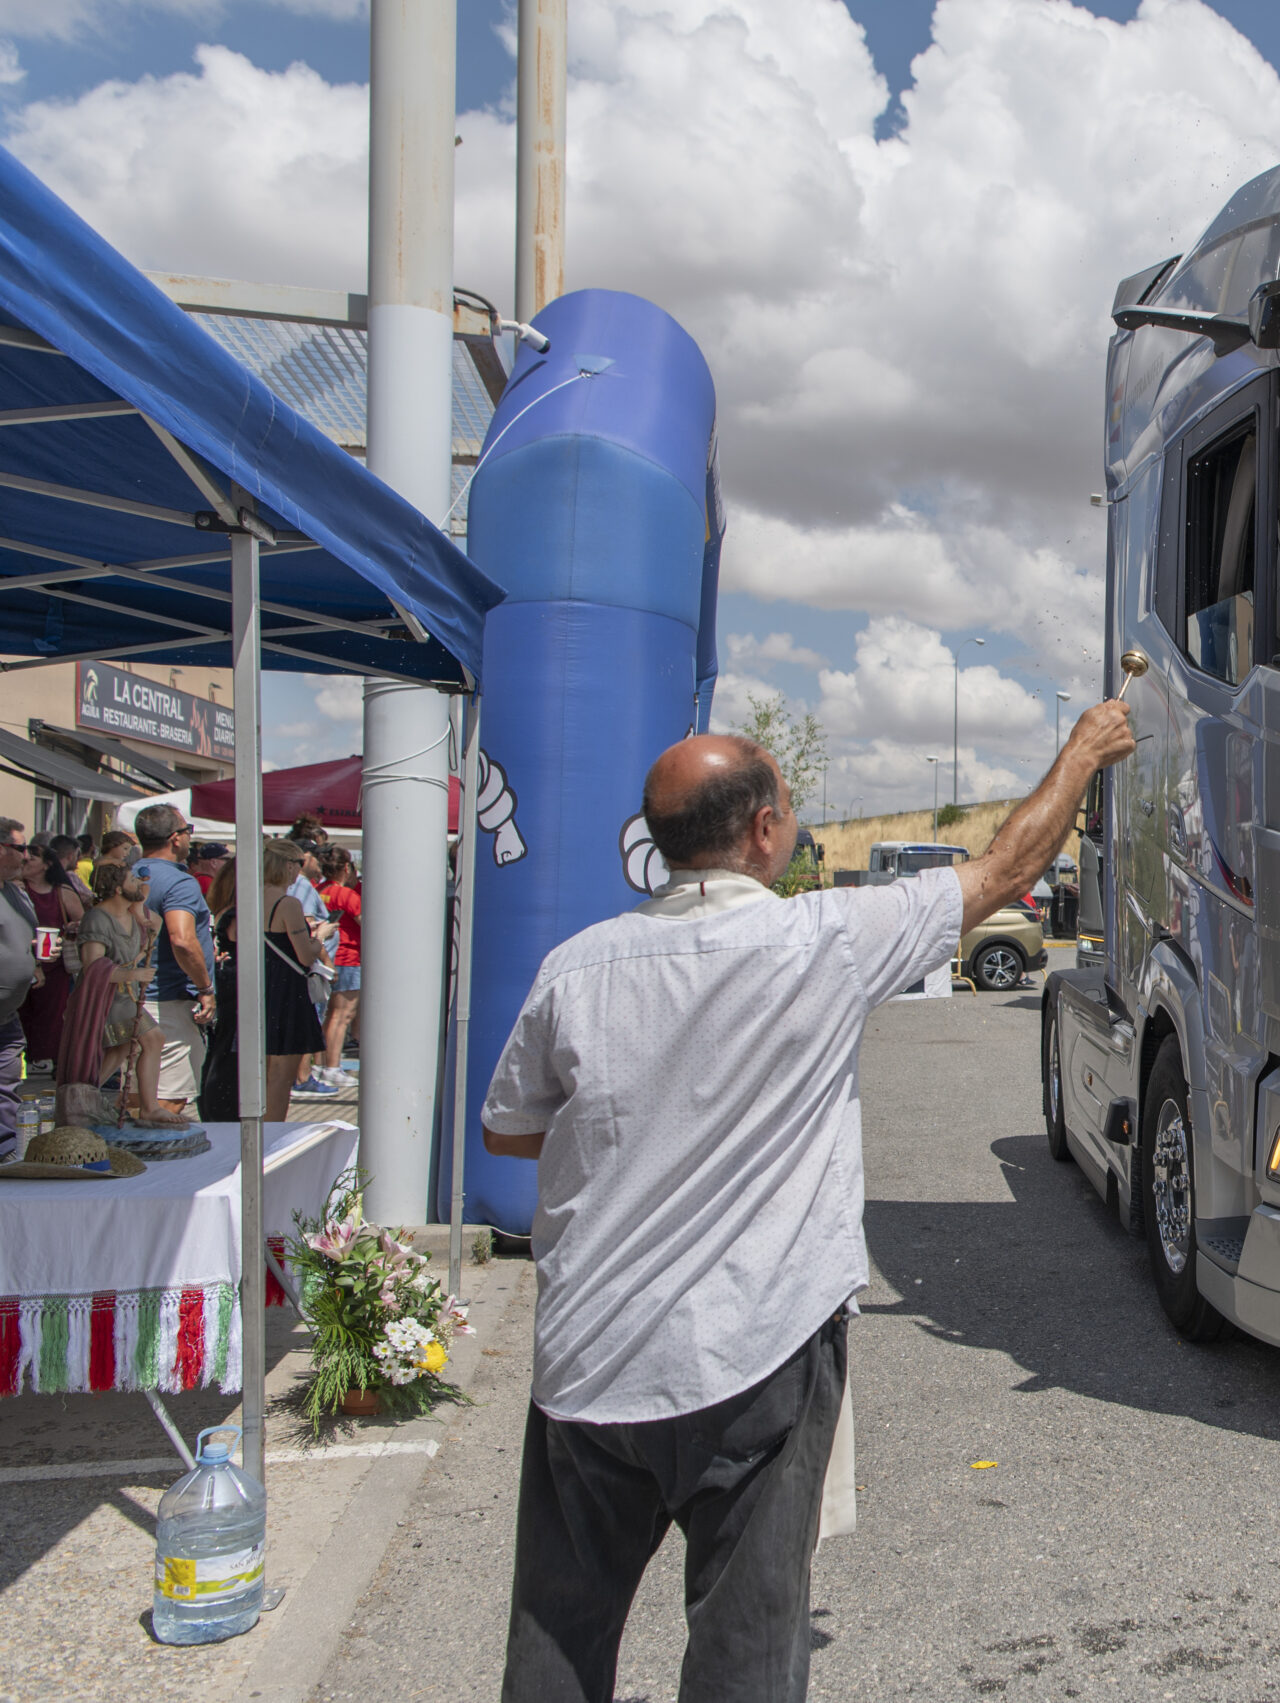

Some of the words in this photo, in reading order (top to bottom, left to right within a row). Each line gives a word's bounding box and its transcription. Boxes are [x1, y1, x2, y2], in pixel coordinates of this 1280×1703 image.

[114, 677, 131, 704] LA
[133, 684, 184, 721] CENTRAL
[103, 707, 158, 736] RESTAURANTE
